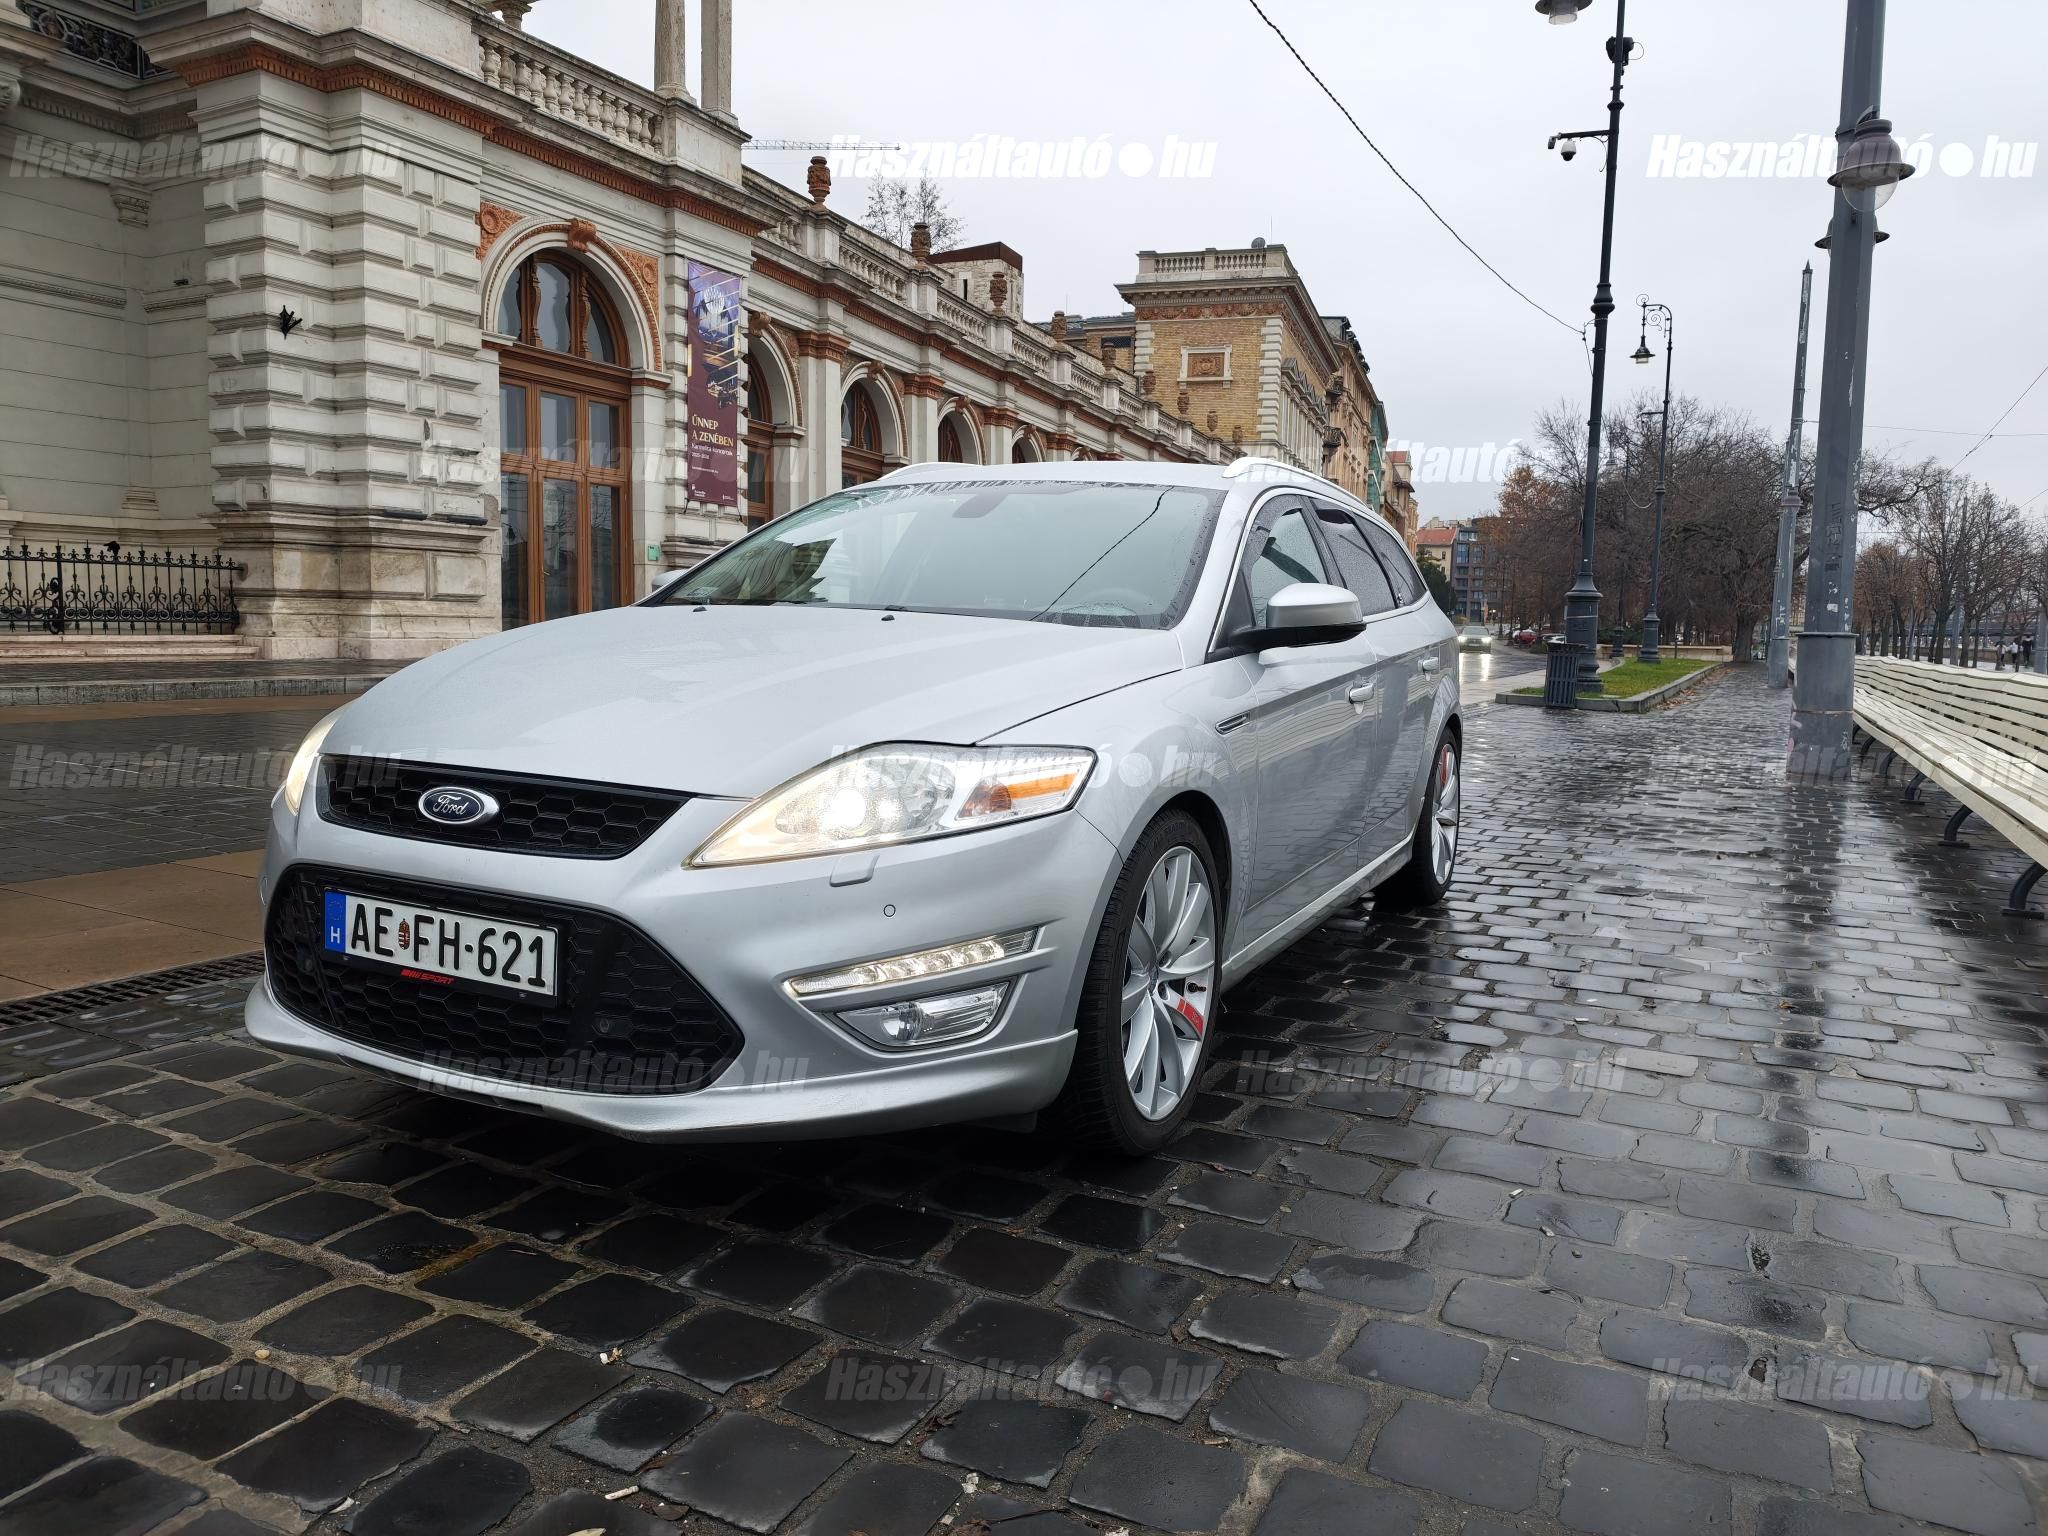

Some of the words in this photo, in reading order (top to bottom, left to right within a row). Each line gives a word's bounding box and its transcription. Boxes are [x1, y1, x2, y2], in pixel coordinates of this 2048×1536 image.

[692, 430, 698, 440] A
[699, 431, 734, 447] ZENÉBEN
[433, 794, 469, 815] Ford
[331, 926, 340, 944] H
[351, 903, 394, 957] AE
[413, 914, 546, 988] FH-621
[421, 973, 454, 985] SPORT
